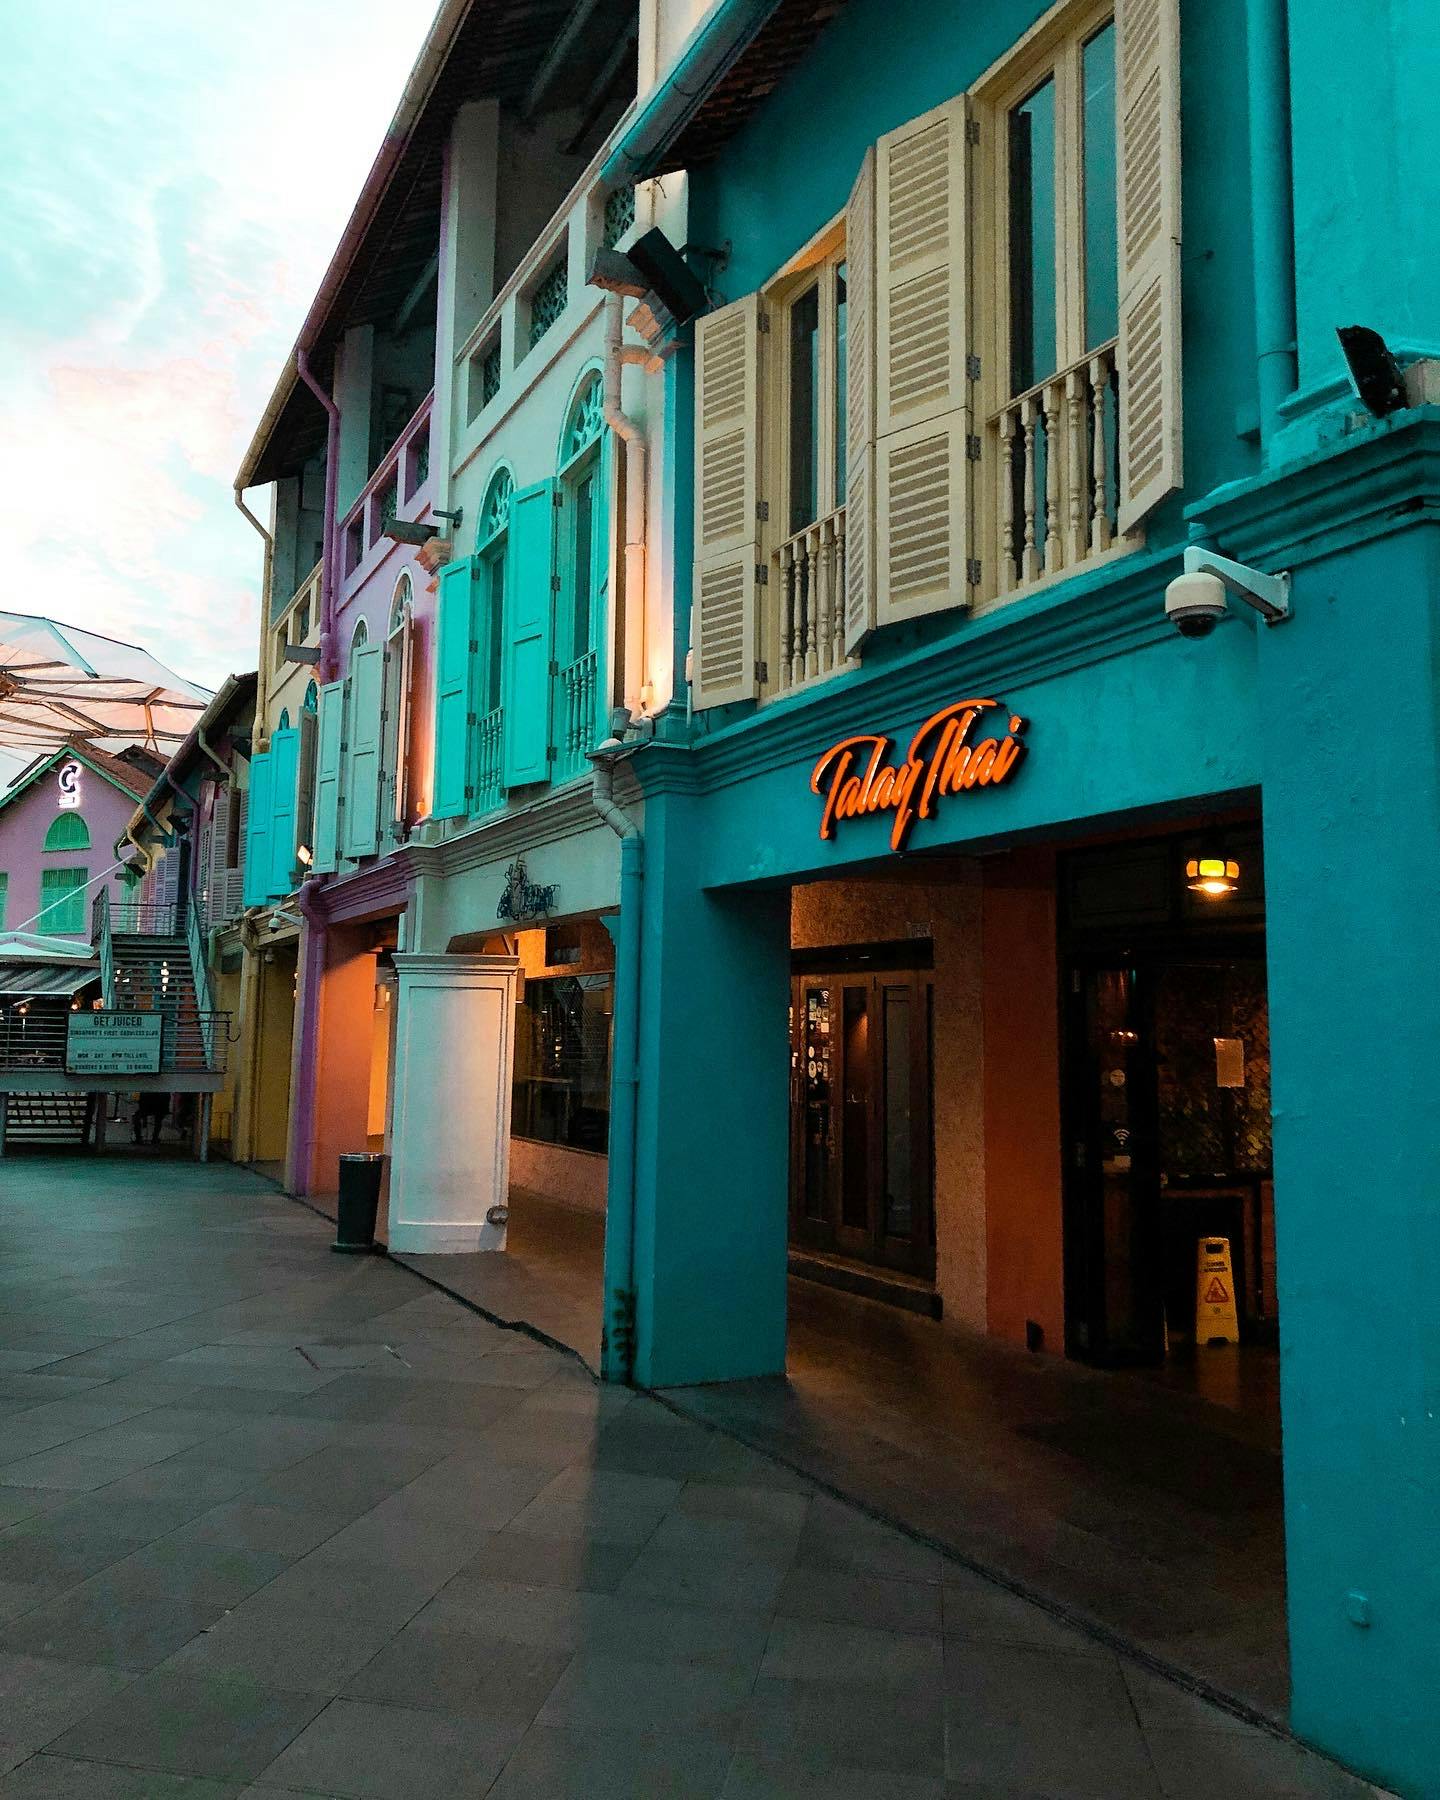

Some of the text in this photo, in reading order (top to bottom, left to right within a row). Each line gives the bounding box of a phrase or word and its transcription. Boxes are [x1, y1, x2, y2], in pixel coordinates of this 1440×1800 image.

[810, 698, 1022, 851] Talay Thai
[93, 1016, 142, 1026] GET JUICED
